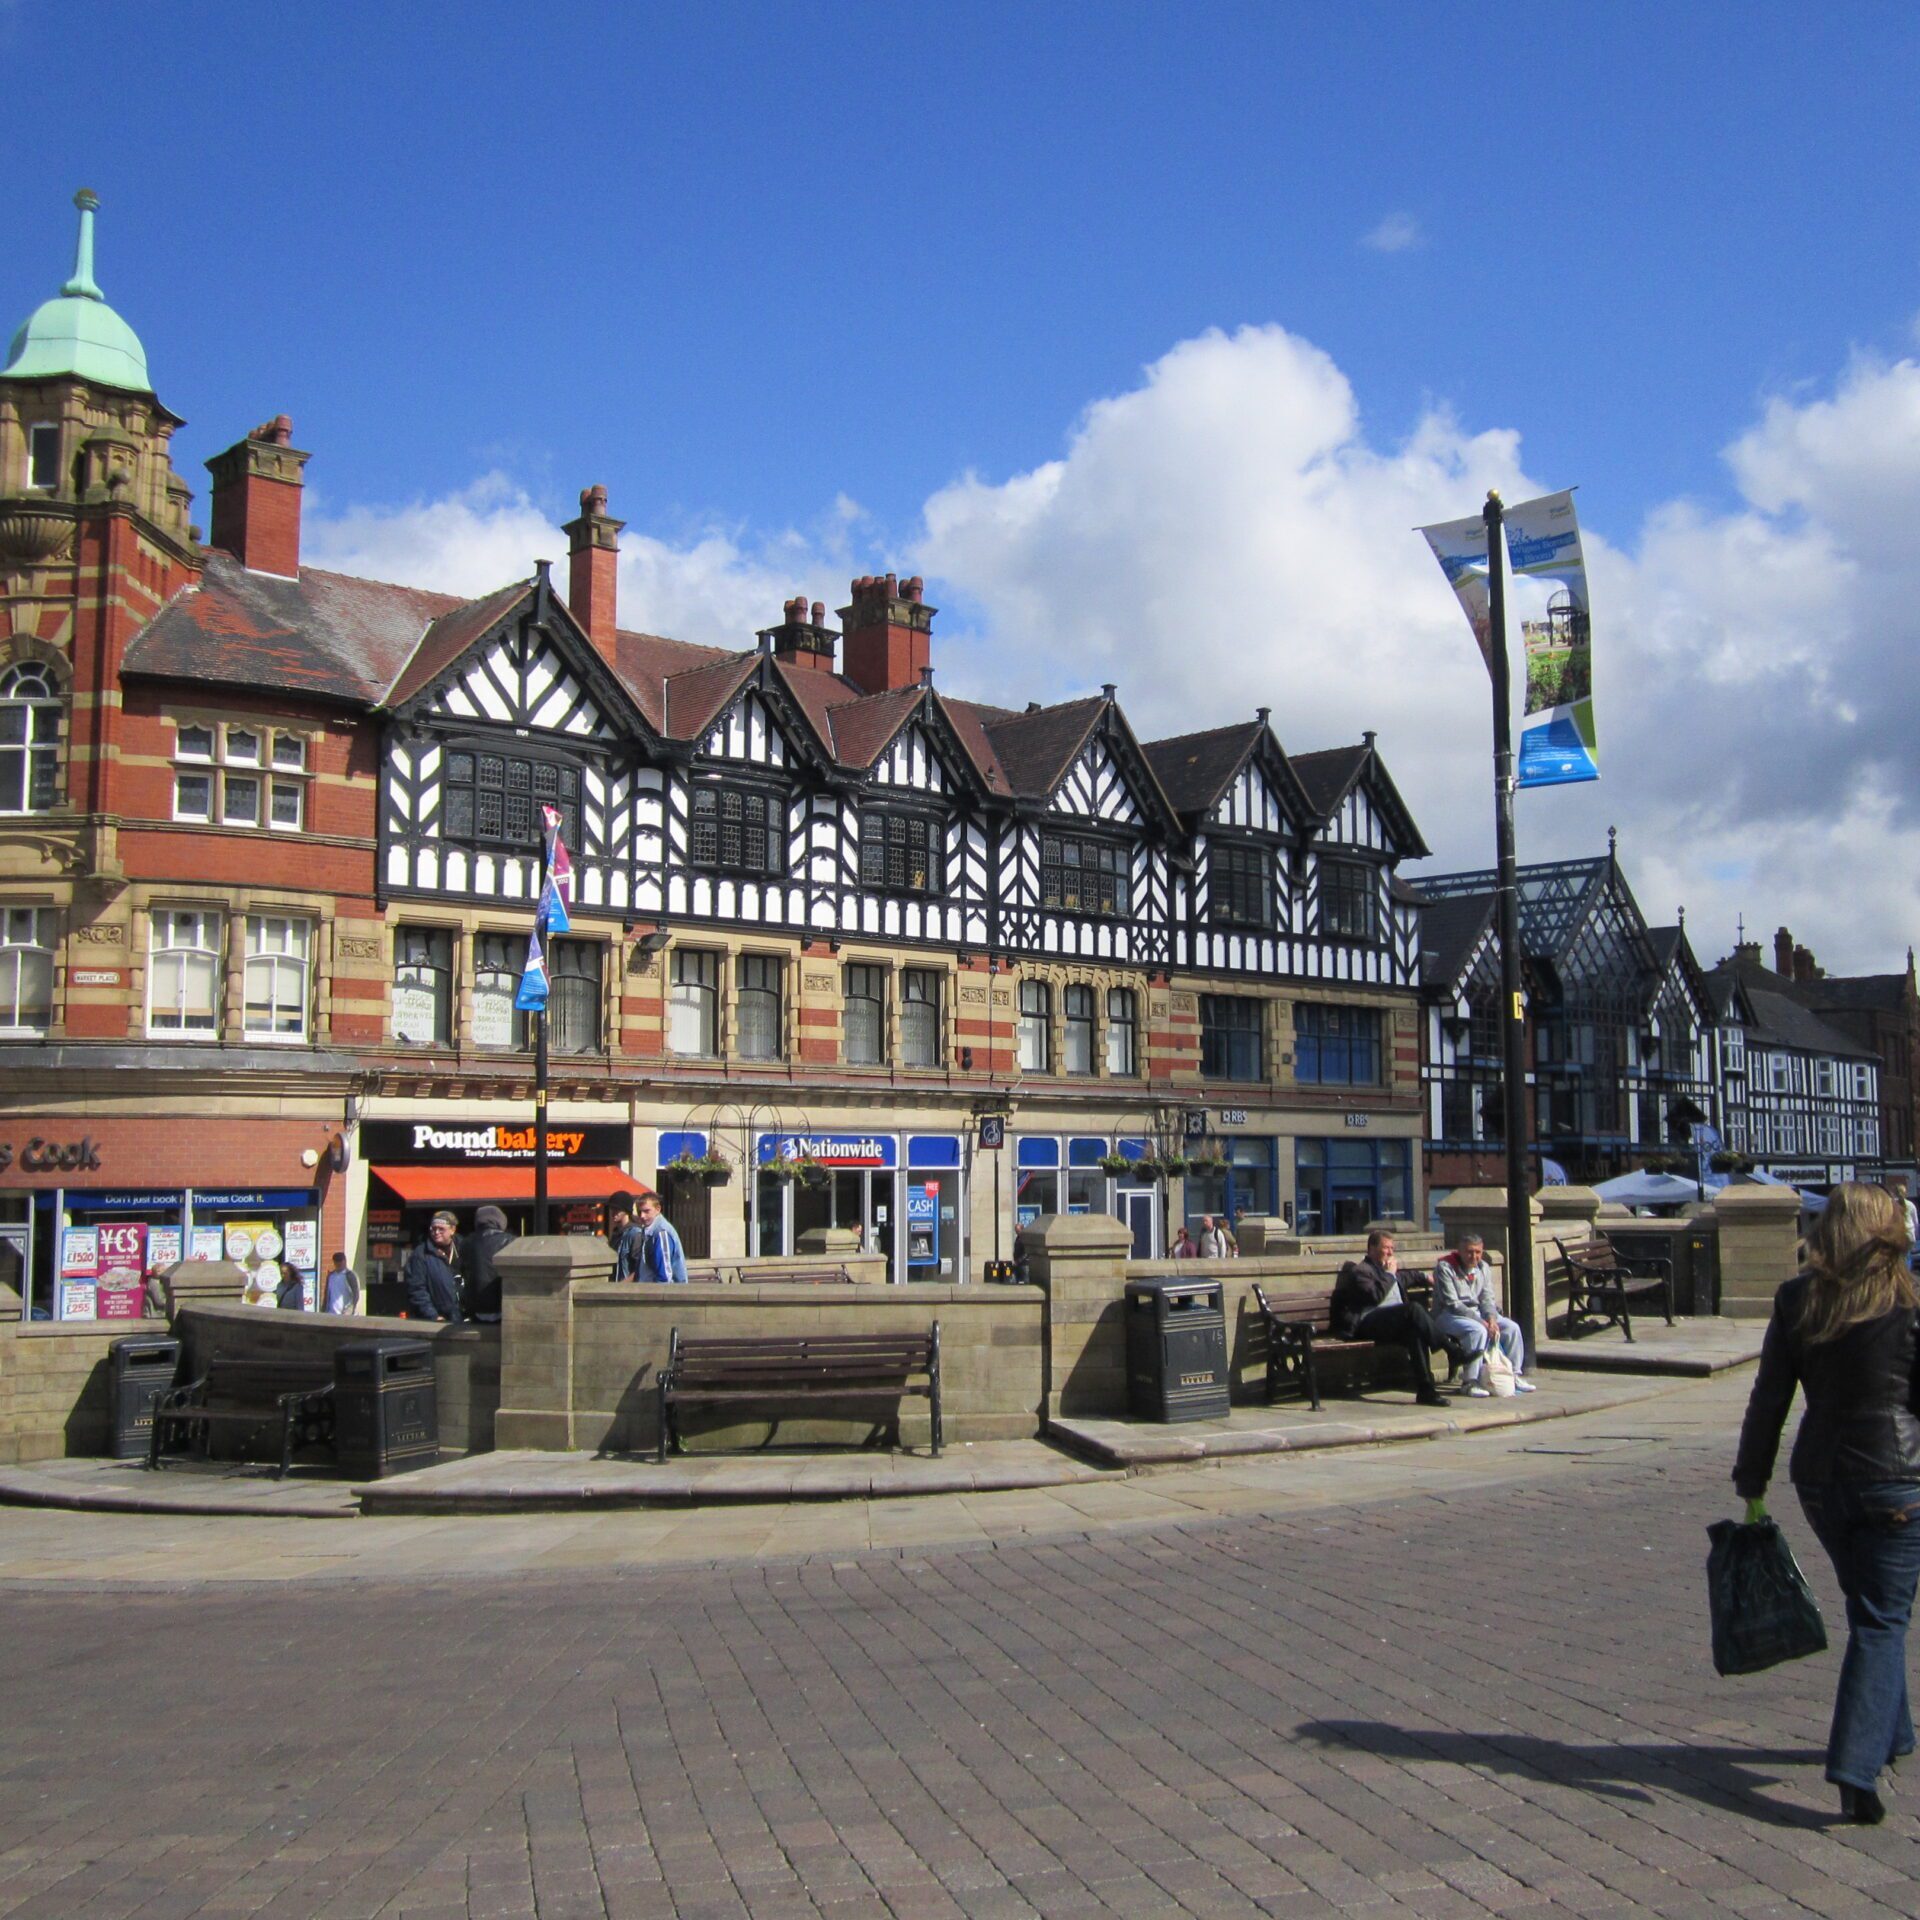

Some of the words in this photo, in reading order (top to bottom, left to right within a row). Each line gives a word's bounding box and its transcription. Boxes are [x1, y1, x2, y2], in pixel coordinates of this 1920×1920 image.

[1231, 1111, 1248, 1123] RBS
[1354, 1114, 1369, 1126] RBS
[24, 1136, 101, 1165] Cook
[798, 1138, 883, 1158] Nationwide
[193, 1194, 229, 1204] Thomas
[230, 1194, 254, 1203] Cook
[908, 1199, 934, 1212] CASH
[67, 1252, 95, 1264] £1520
[151, 1249, 177, 1261] £849
[1181, 1374, 1214, 1385] LITTER
